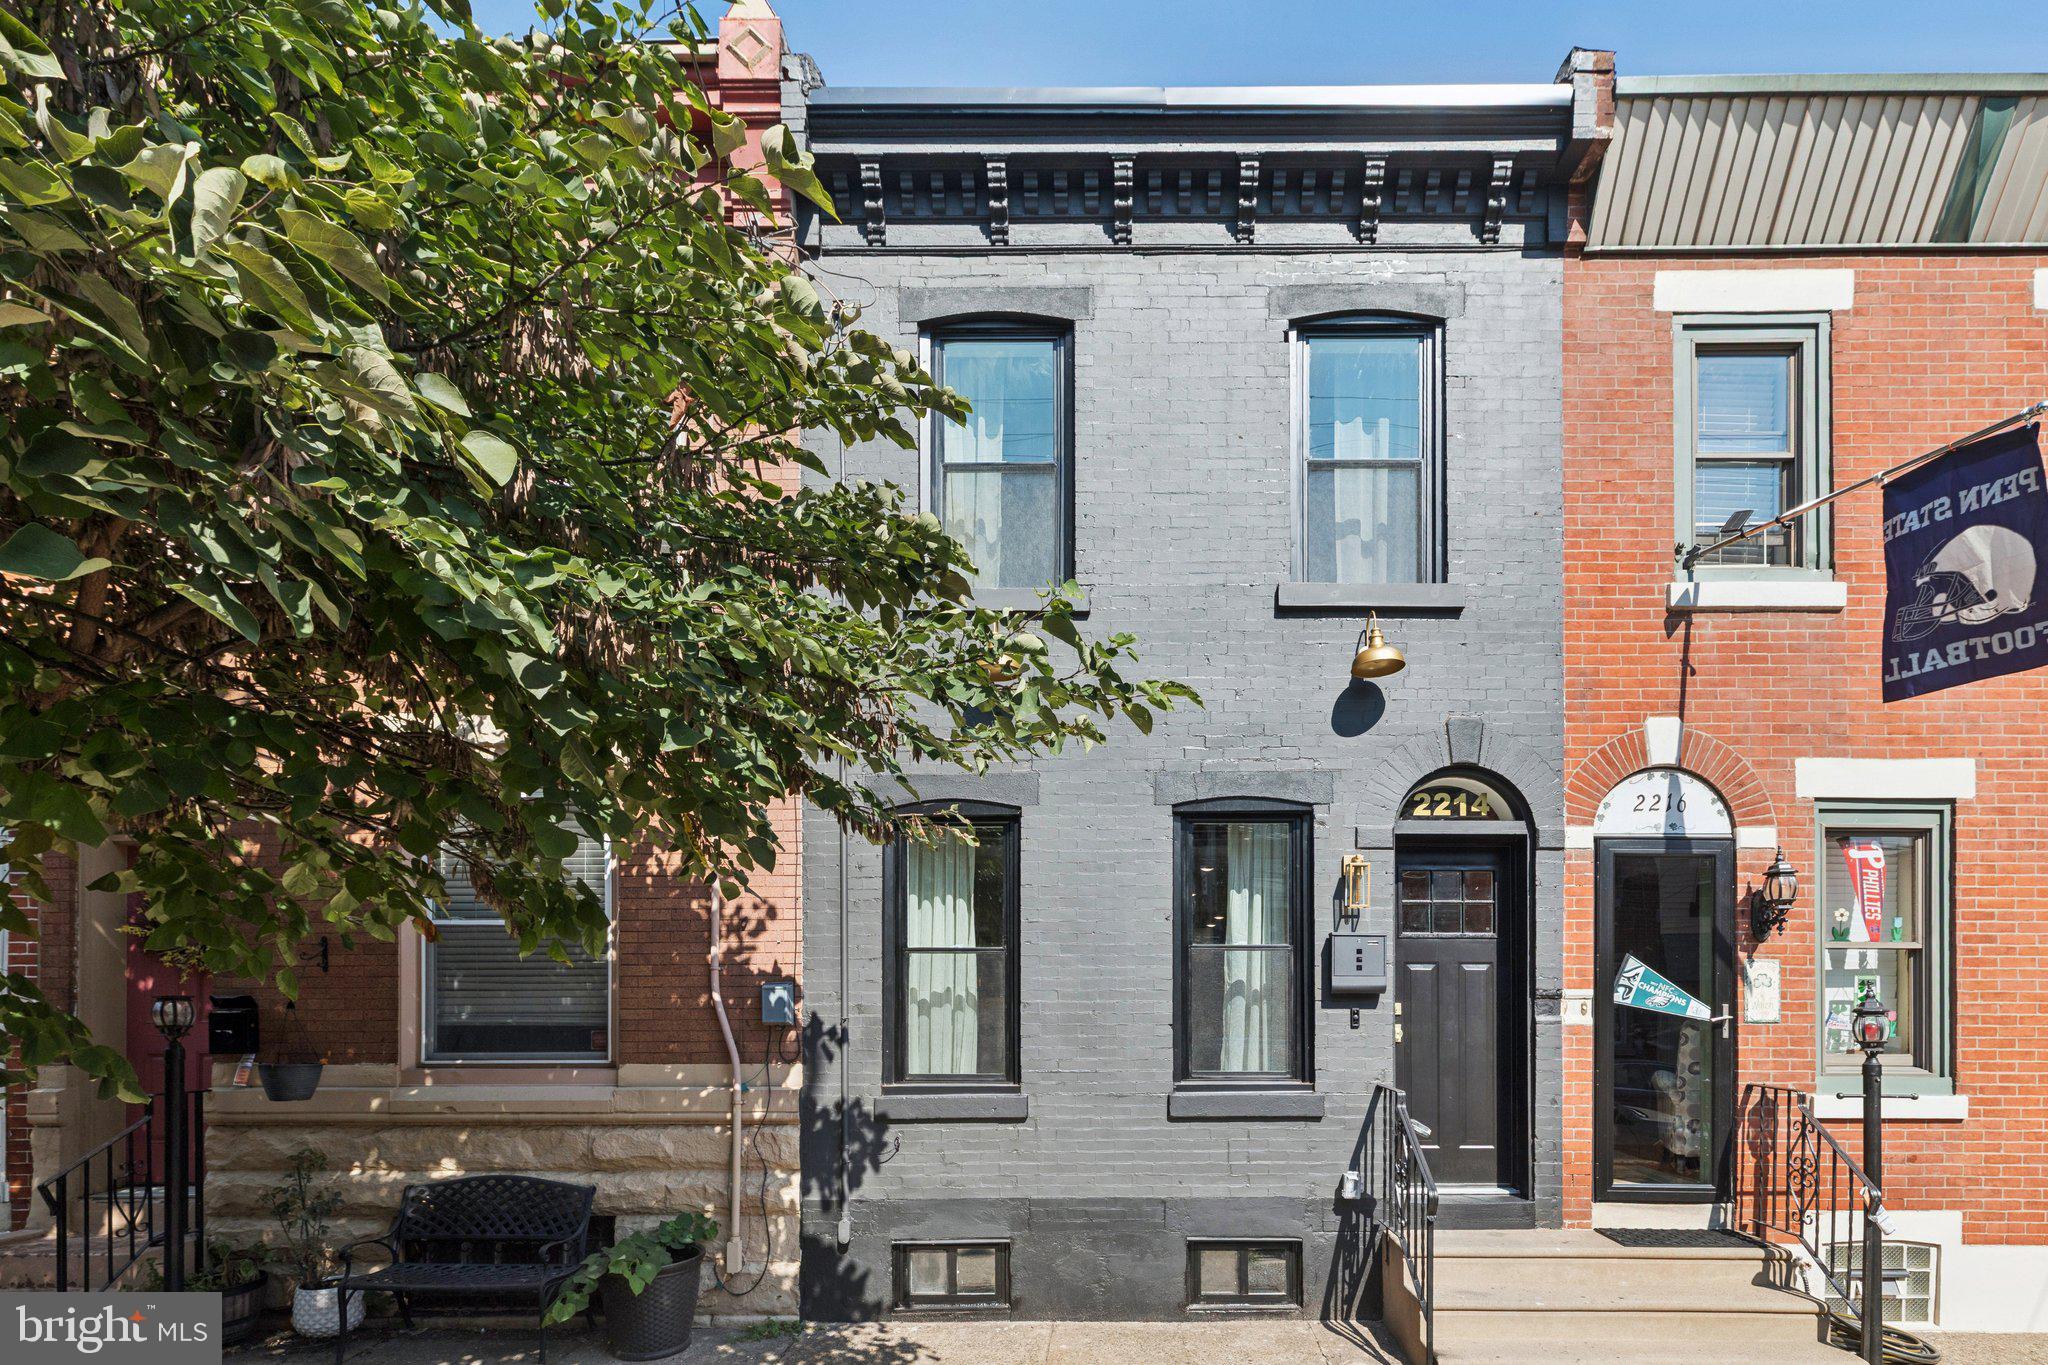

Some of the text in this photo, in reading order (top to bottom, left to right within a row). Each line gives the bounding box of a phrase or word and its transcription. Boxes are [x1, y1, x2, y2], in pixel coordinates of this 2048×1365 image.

[1412, 792, 1490, 817] 2214
[1633, 792, 1687, 813] 2216
[1862, 869, 1882, 921] PHILLIES
[1638, 981, 1687, 1006] CHAMPIONS
[1659, 982, 1676, 993] NFC
